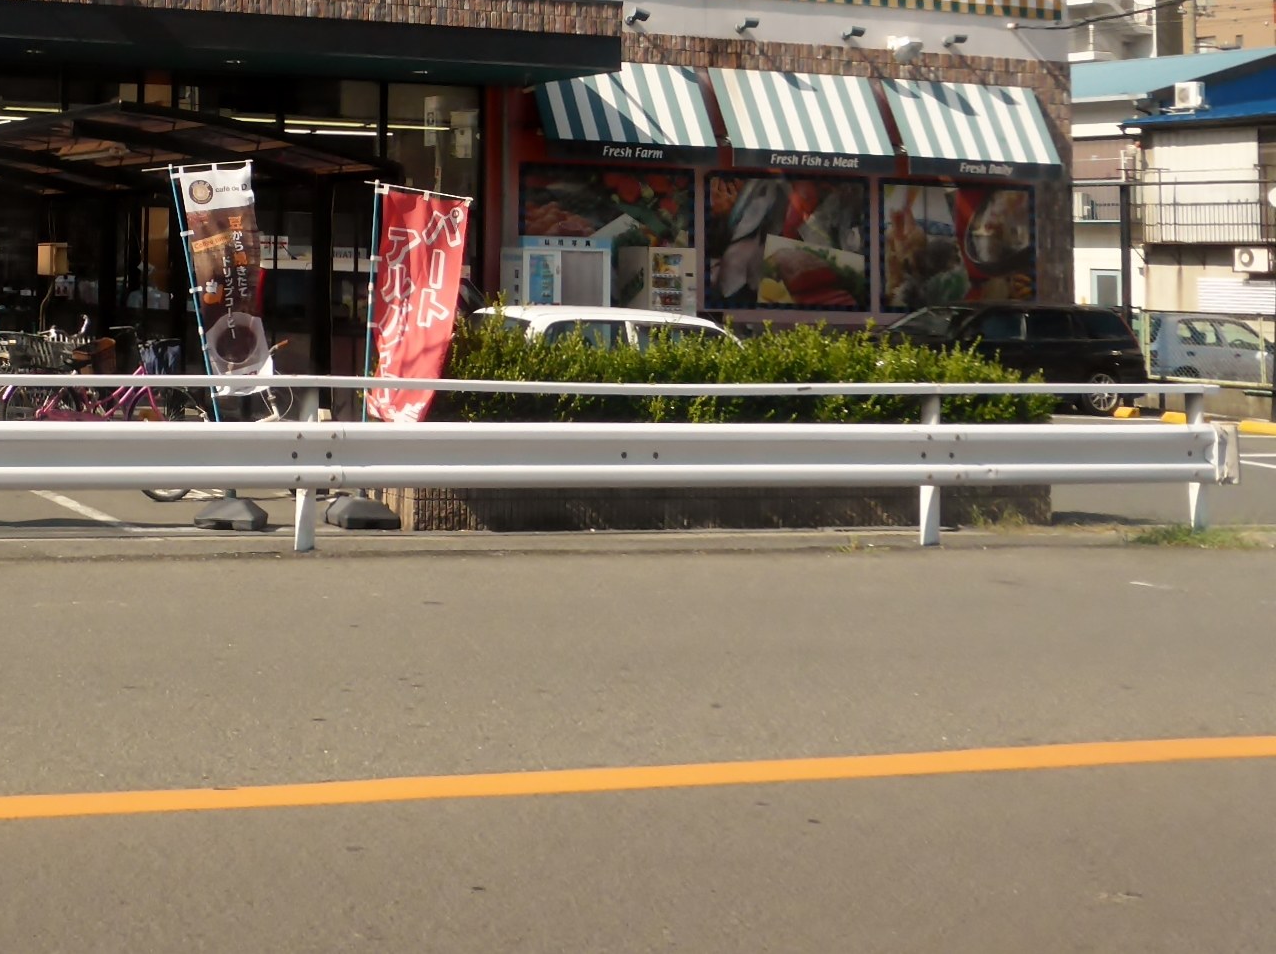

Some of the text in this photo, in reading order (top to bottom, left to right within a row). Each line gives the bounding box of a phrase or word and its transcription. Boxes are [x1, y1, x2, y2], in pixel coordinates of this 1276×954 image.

[602, 145, 664, 159] Fresh Farm
[770, 153, 799, 165] Fresh
[801, 154, 822, 166] Fish
[832, 156, 860, 168] Meat
[222, 255, 236, 340] ドリップコーヒー
